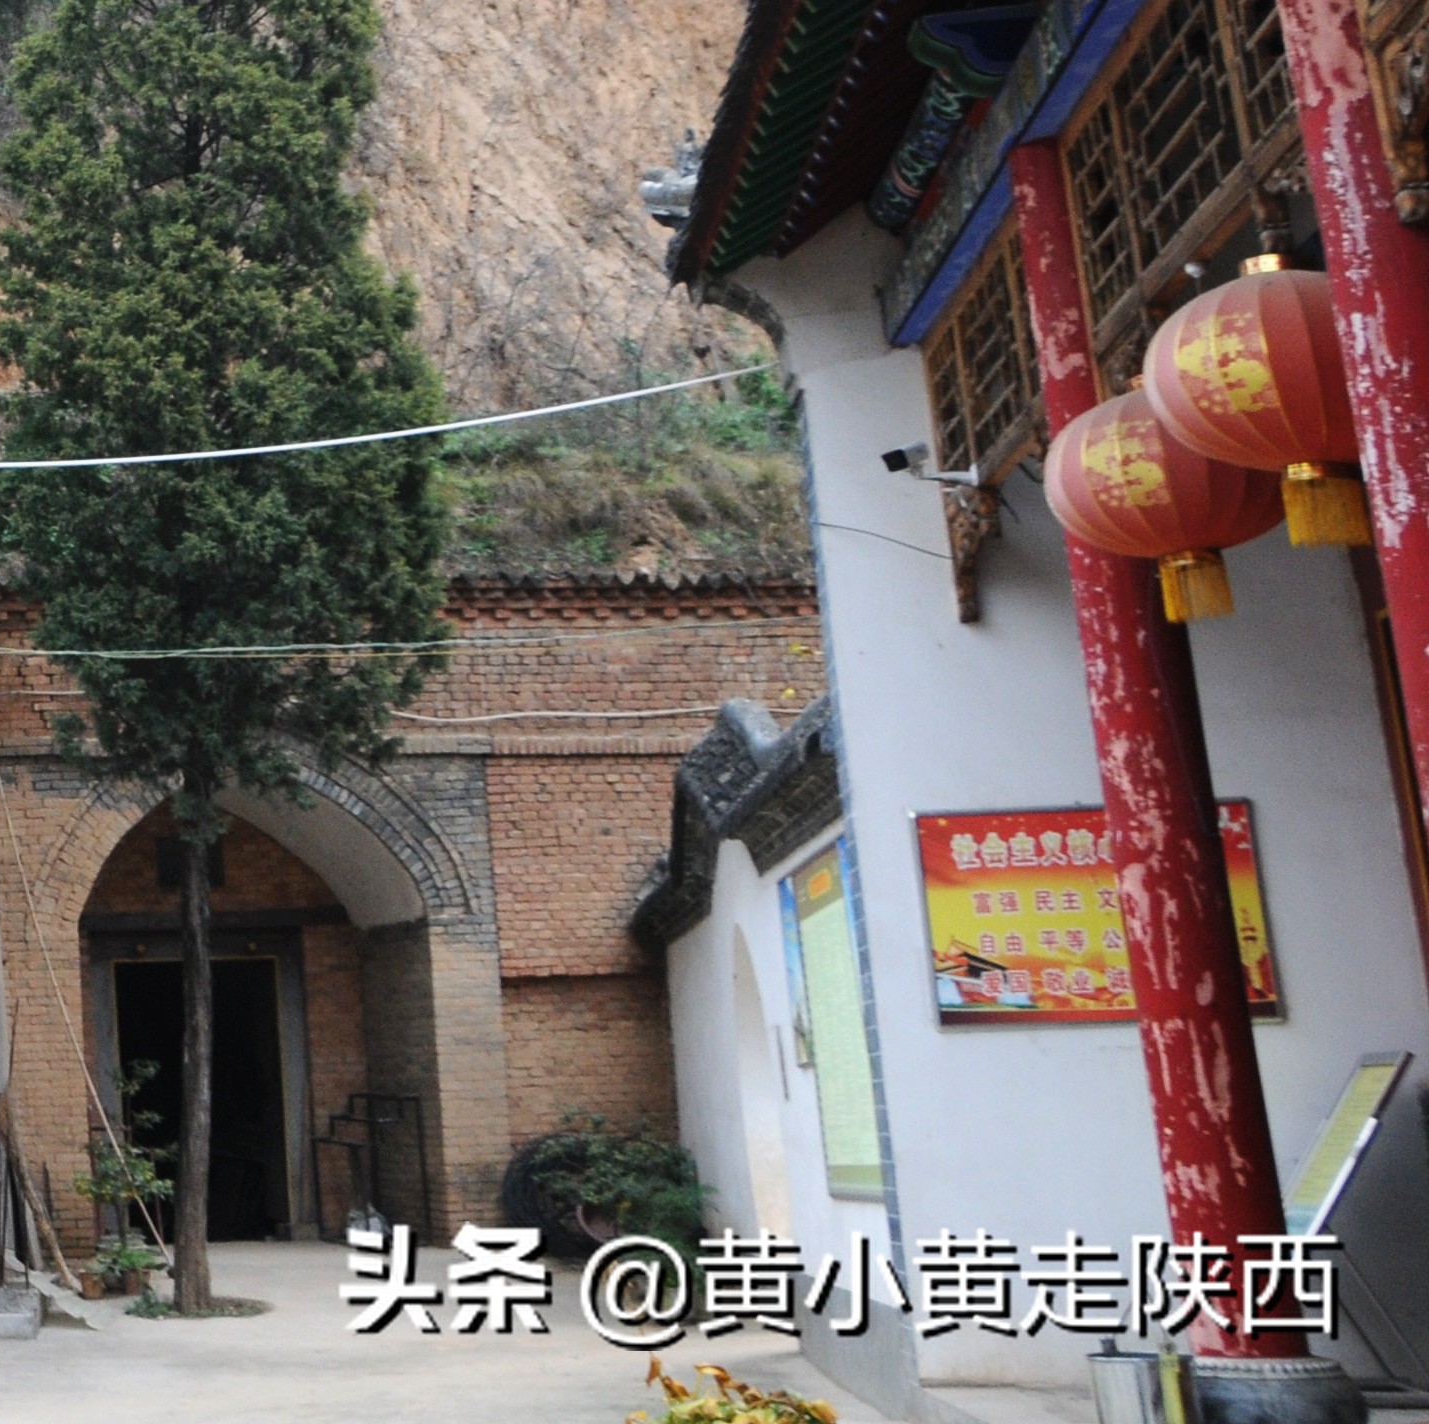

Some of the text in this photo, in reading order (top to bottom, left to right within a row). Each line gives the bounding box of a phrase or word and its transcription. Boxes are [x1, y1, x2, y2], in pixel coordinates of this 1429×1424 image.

[973, 890, 1020, 915] 富强
[1034, 889, 1082, 912] 民主
[979, 932, 1025, 955] 自由
[1039, 928, 1088, 953] 平等
[982, 970, 1031, 995] 爱国
[1042, 968, 1093, 993] 敬业
